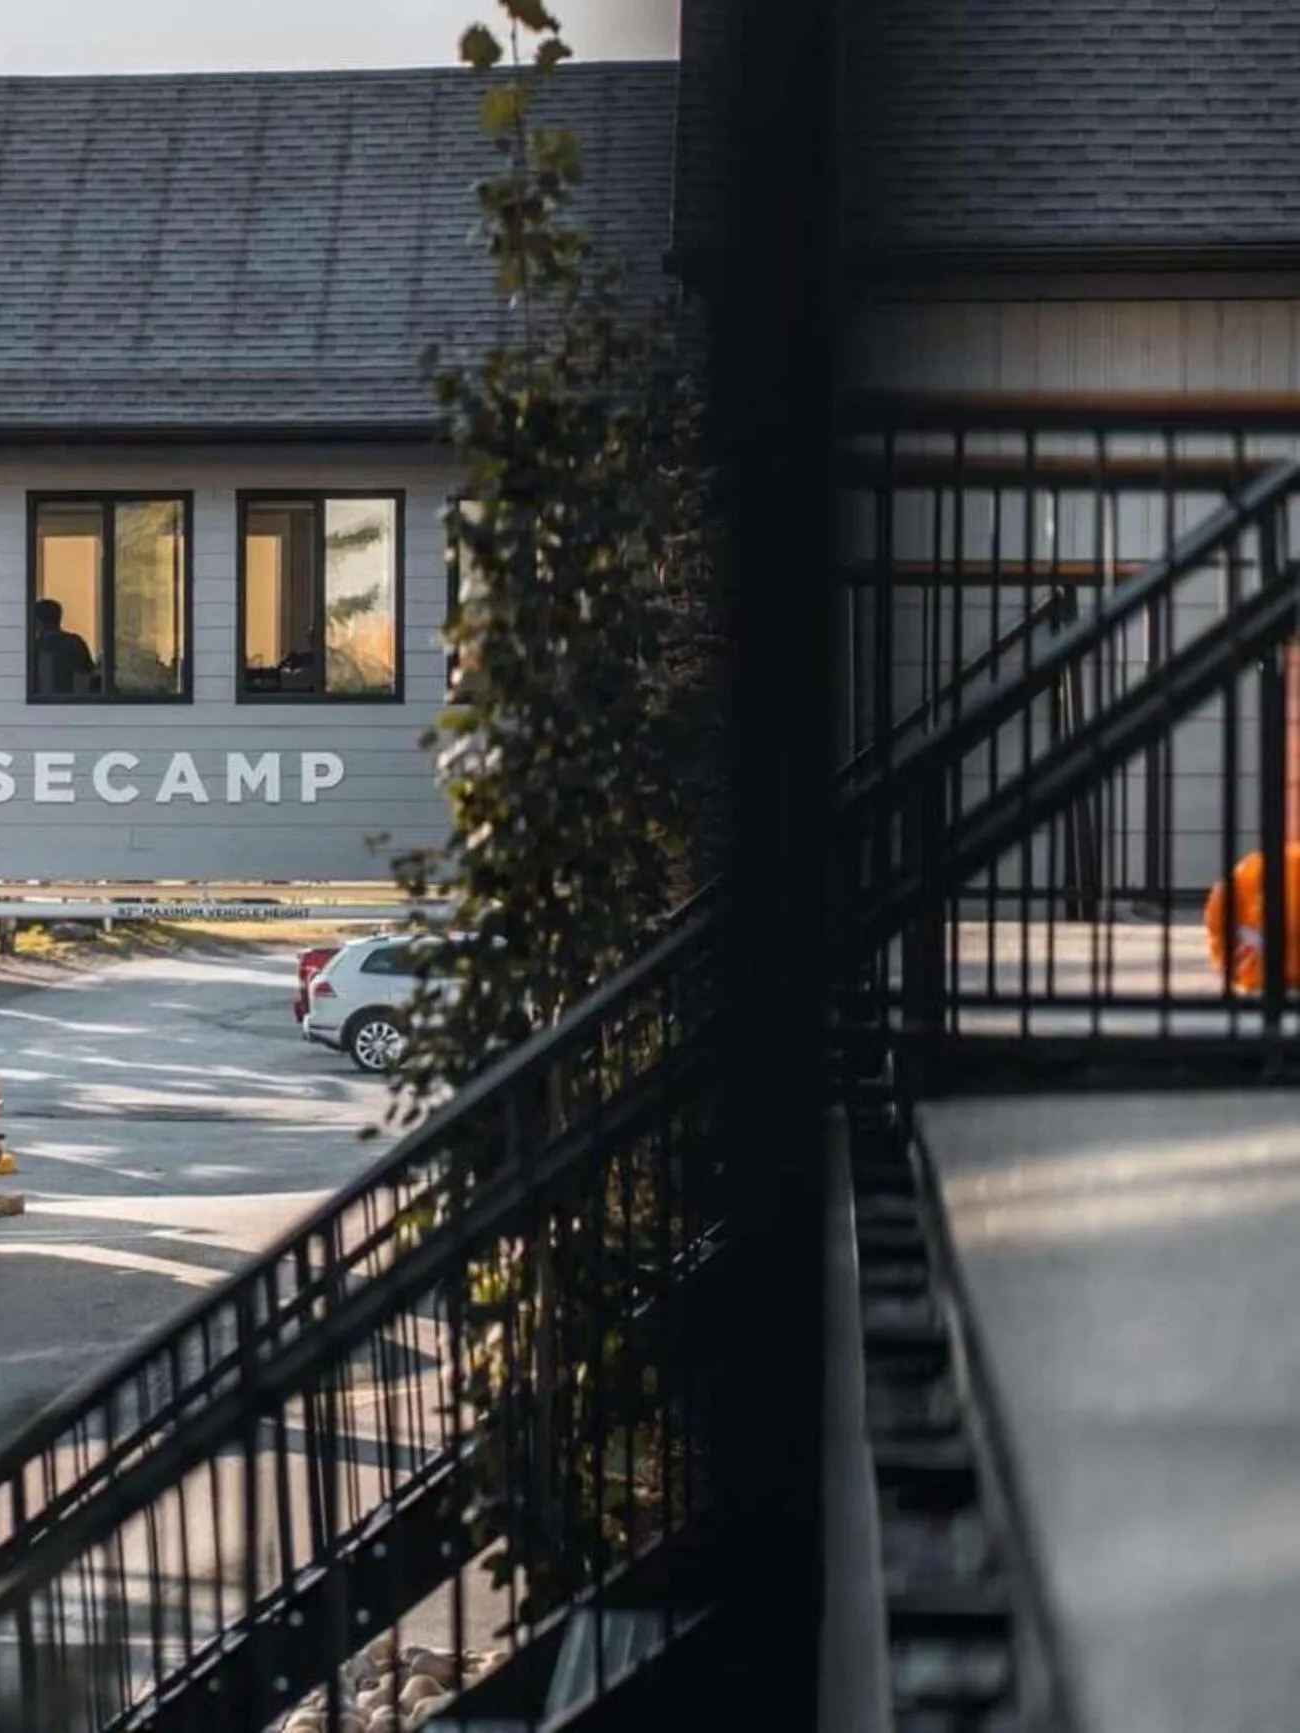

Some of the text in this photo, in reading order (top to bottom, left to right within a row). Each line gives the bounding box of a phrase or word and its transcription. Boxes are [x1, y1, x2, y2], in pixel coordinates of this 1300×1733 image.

[142, 906, 204, 918] MAXIMUM
[209, 907, 259, 918] VEHICLE
[263, 907, 311, 919] HEIGHT
